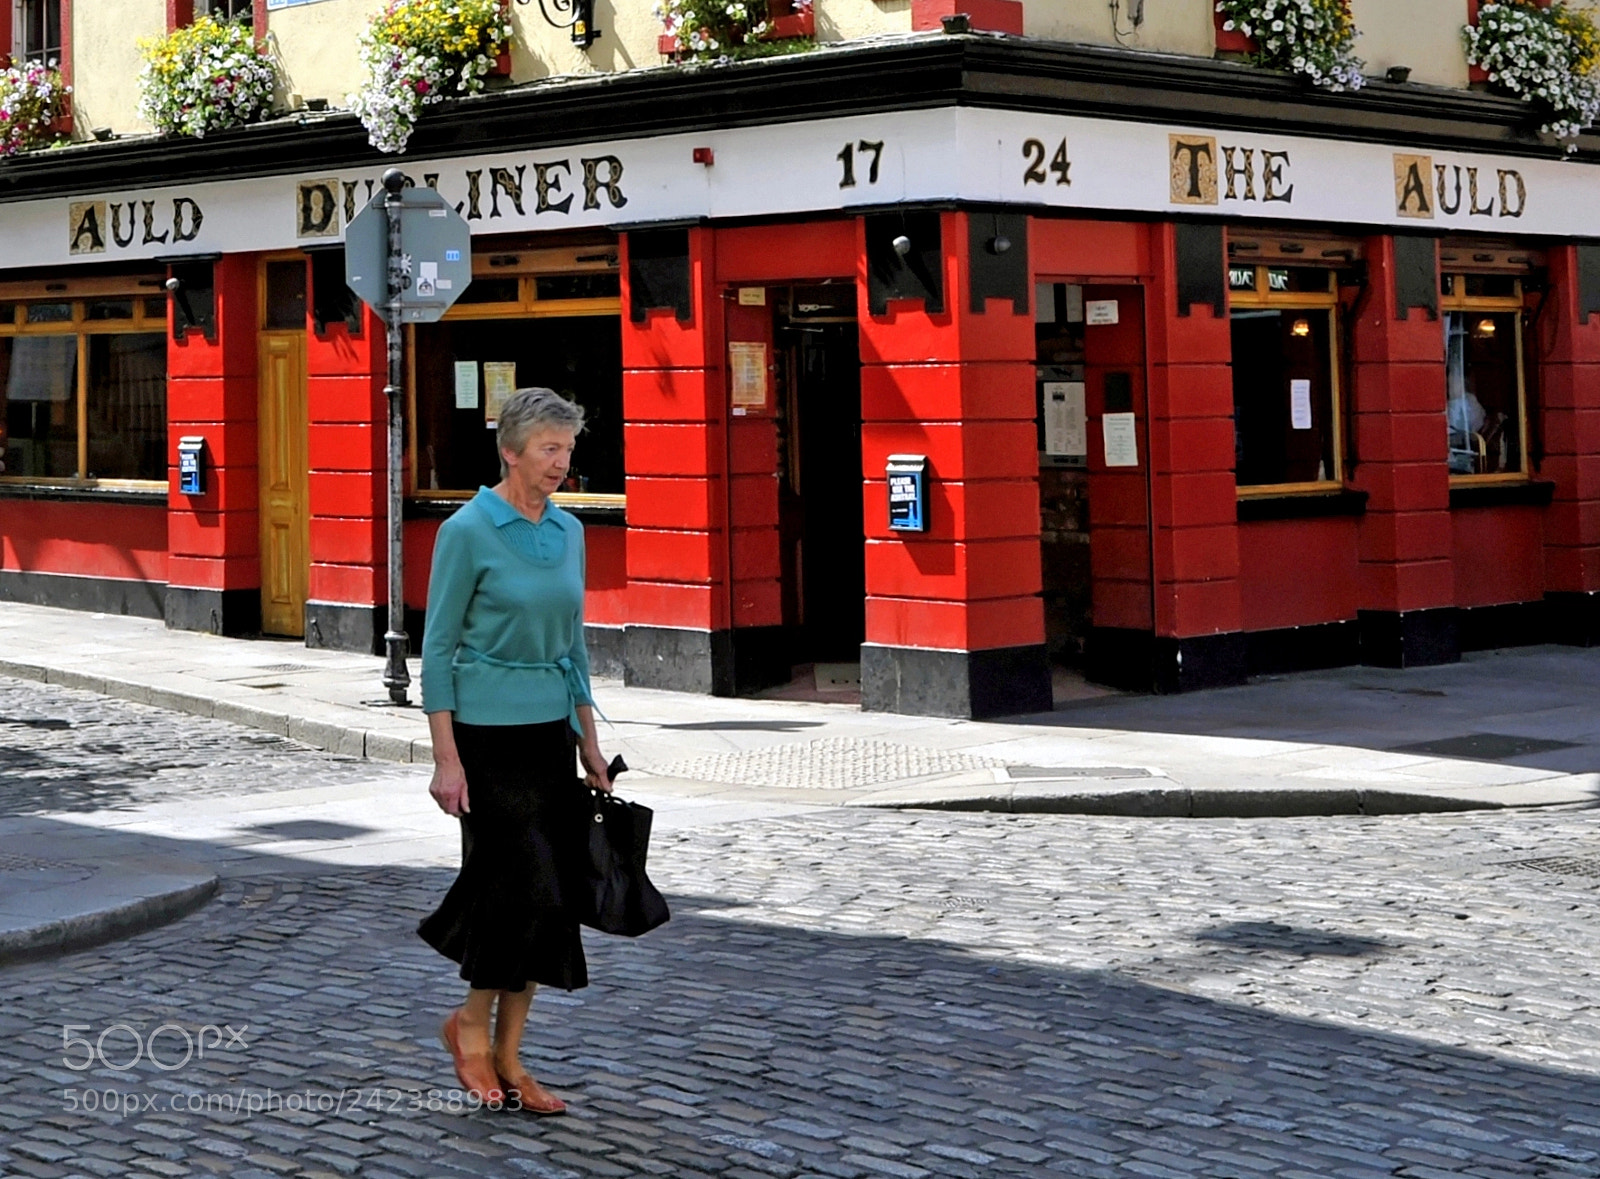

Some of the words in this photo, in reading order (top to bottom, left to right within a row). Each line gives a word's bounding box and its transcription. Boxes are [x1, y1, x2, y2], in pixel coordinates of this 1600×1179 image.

[836, 139, 885, 190] 17
[1021, 135, 1072, 187] 24
[1173, 140, 1295, 204] THE
[1399, 162, 1527, 219] AULD
[70, 198, 204, 249] AULD
